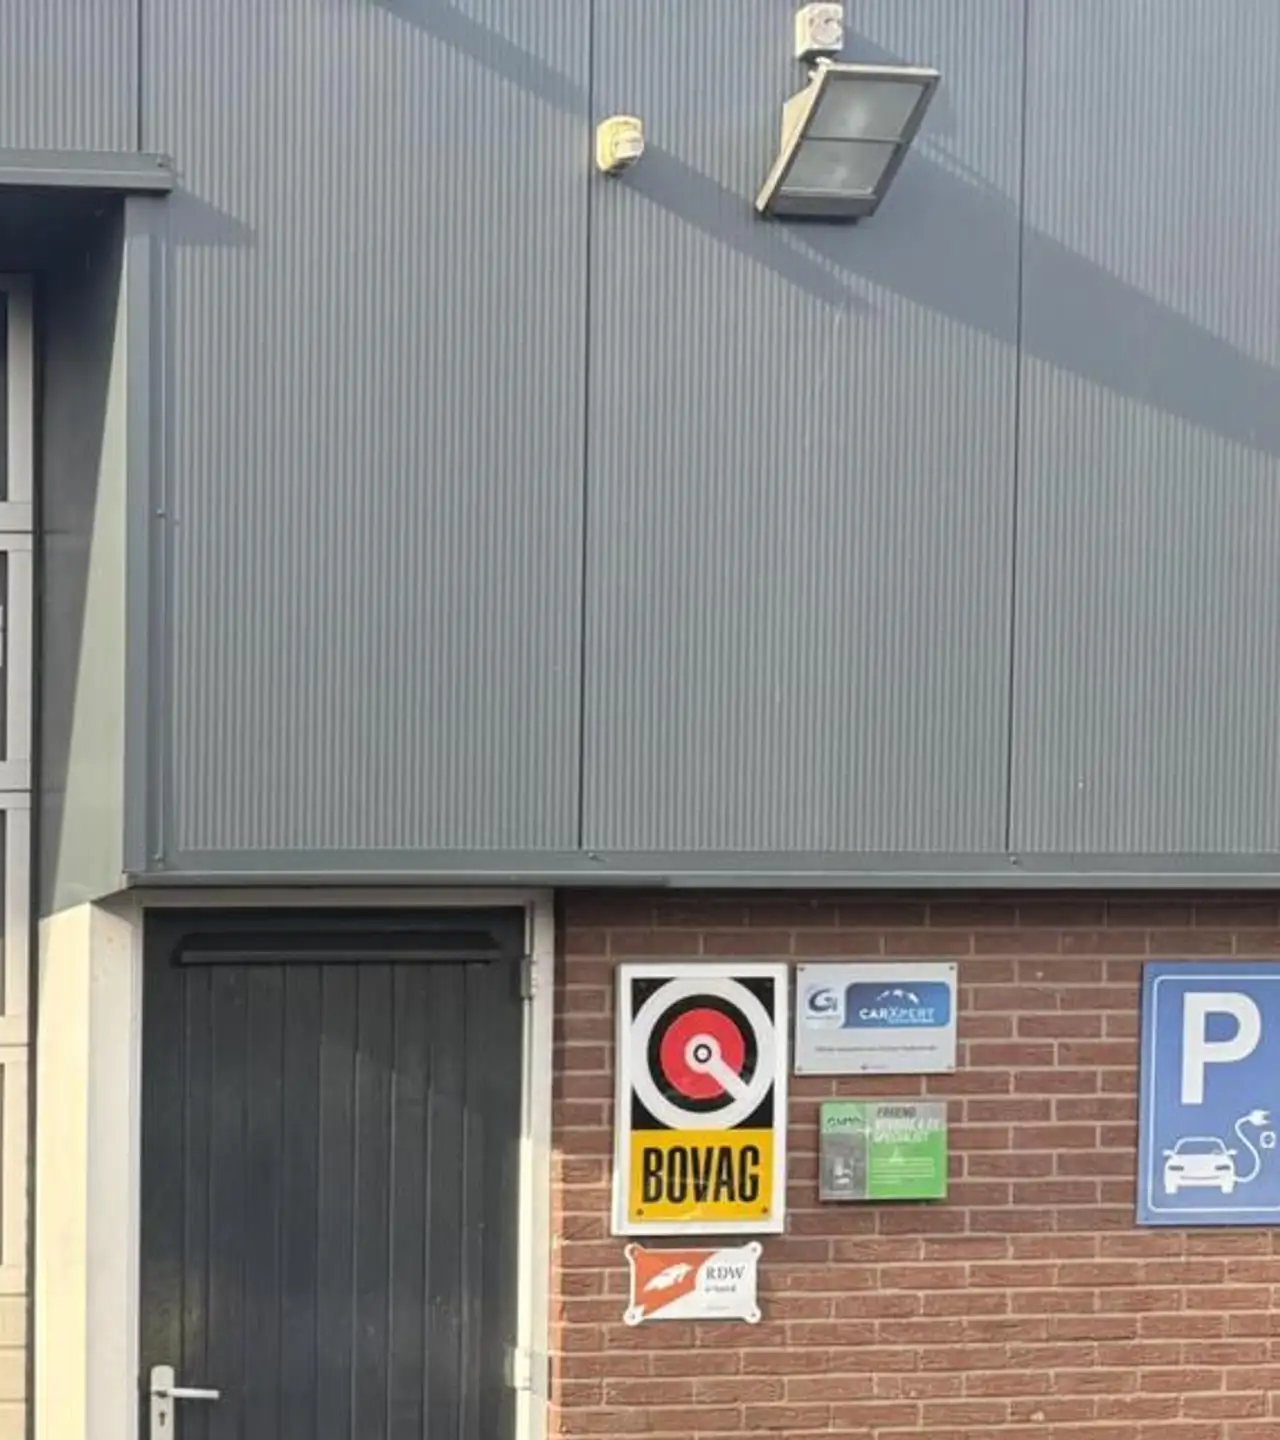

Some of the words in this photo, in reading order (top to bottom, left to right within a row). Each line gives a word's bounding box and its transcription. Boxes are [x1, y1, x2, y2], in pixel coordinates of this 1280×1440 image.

[1181, 991, 1262, 1105] P
[642, 1145, 760, 1203] BOVAG
[705, 1264, 745, 1279] RDW
